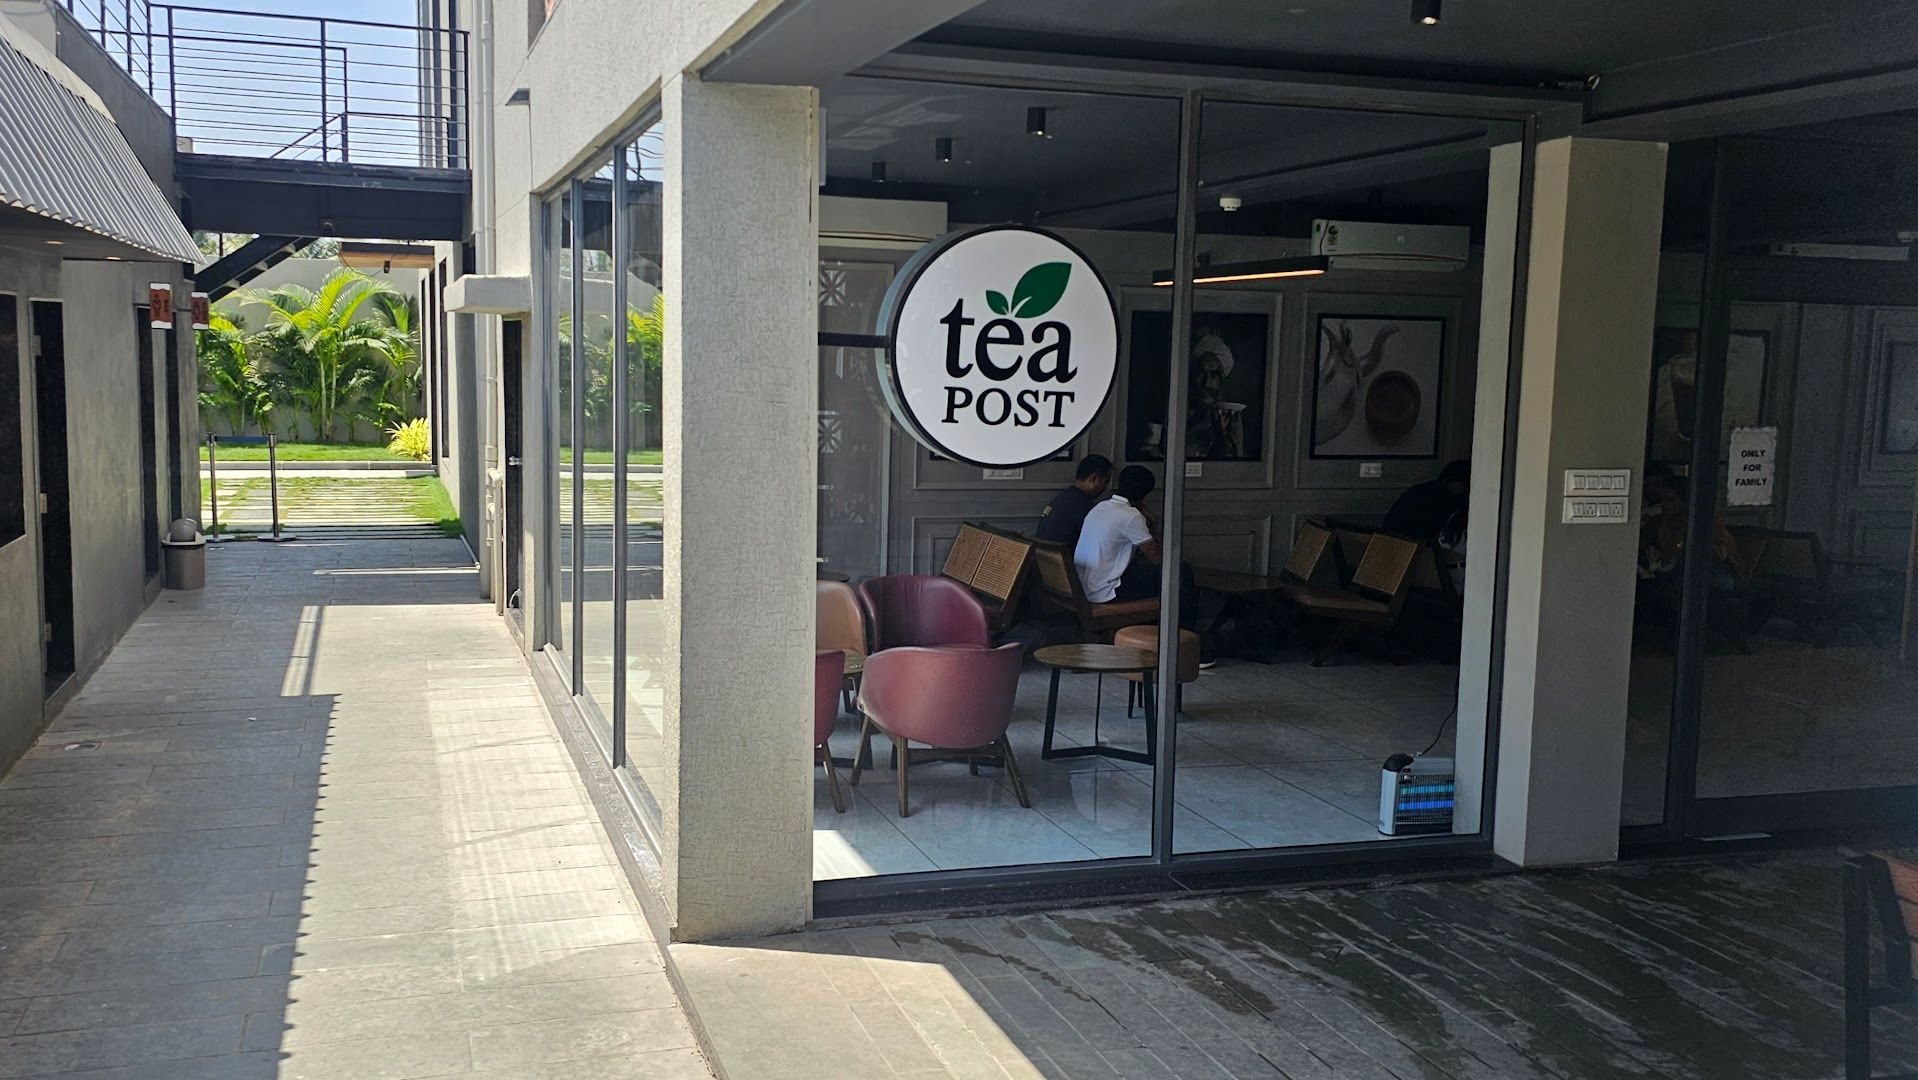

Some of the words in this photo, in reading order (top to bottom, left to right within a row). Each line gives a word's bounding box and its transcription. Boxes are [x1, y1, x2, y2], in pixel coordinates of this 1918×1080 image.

[940, 298, 1078, 383] tea
[941, 386, 1075, 427] POST
[1741, 449, 1766, 458] ONLY
[1743, 464, 1762, 472] FOR
[1735, 478, 1767, 487] FAMILY
